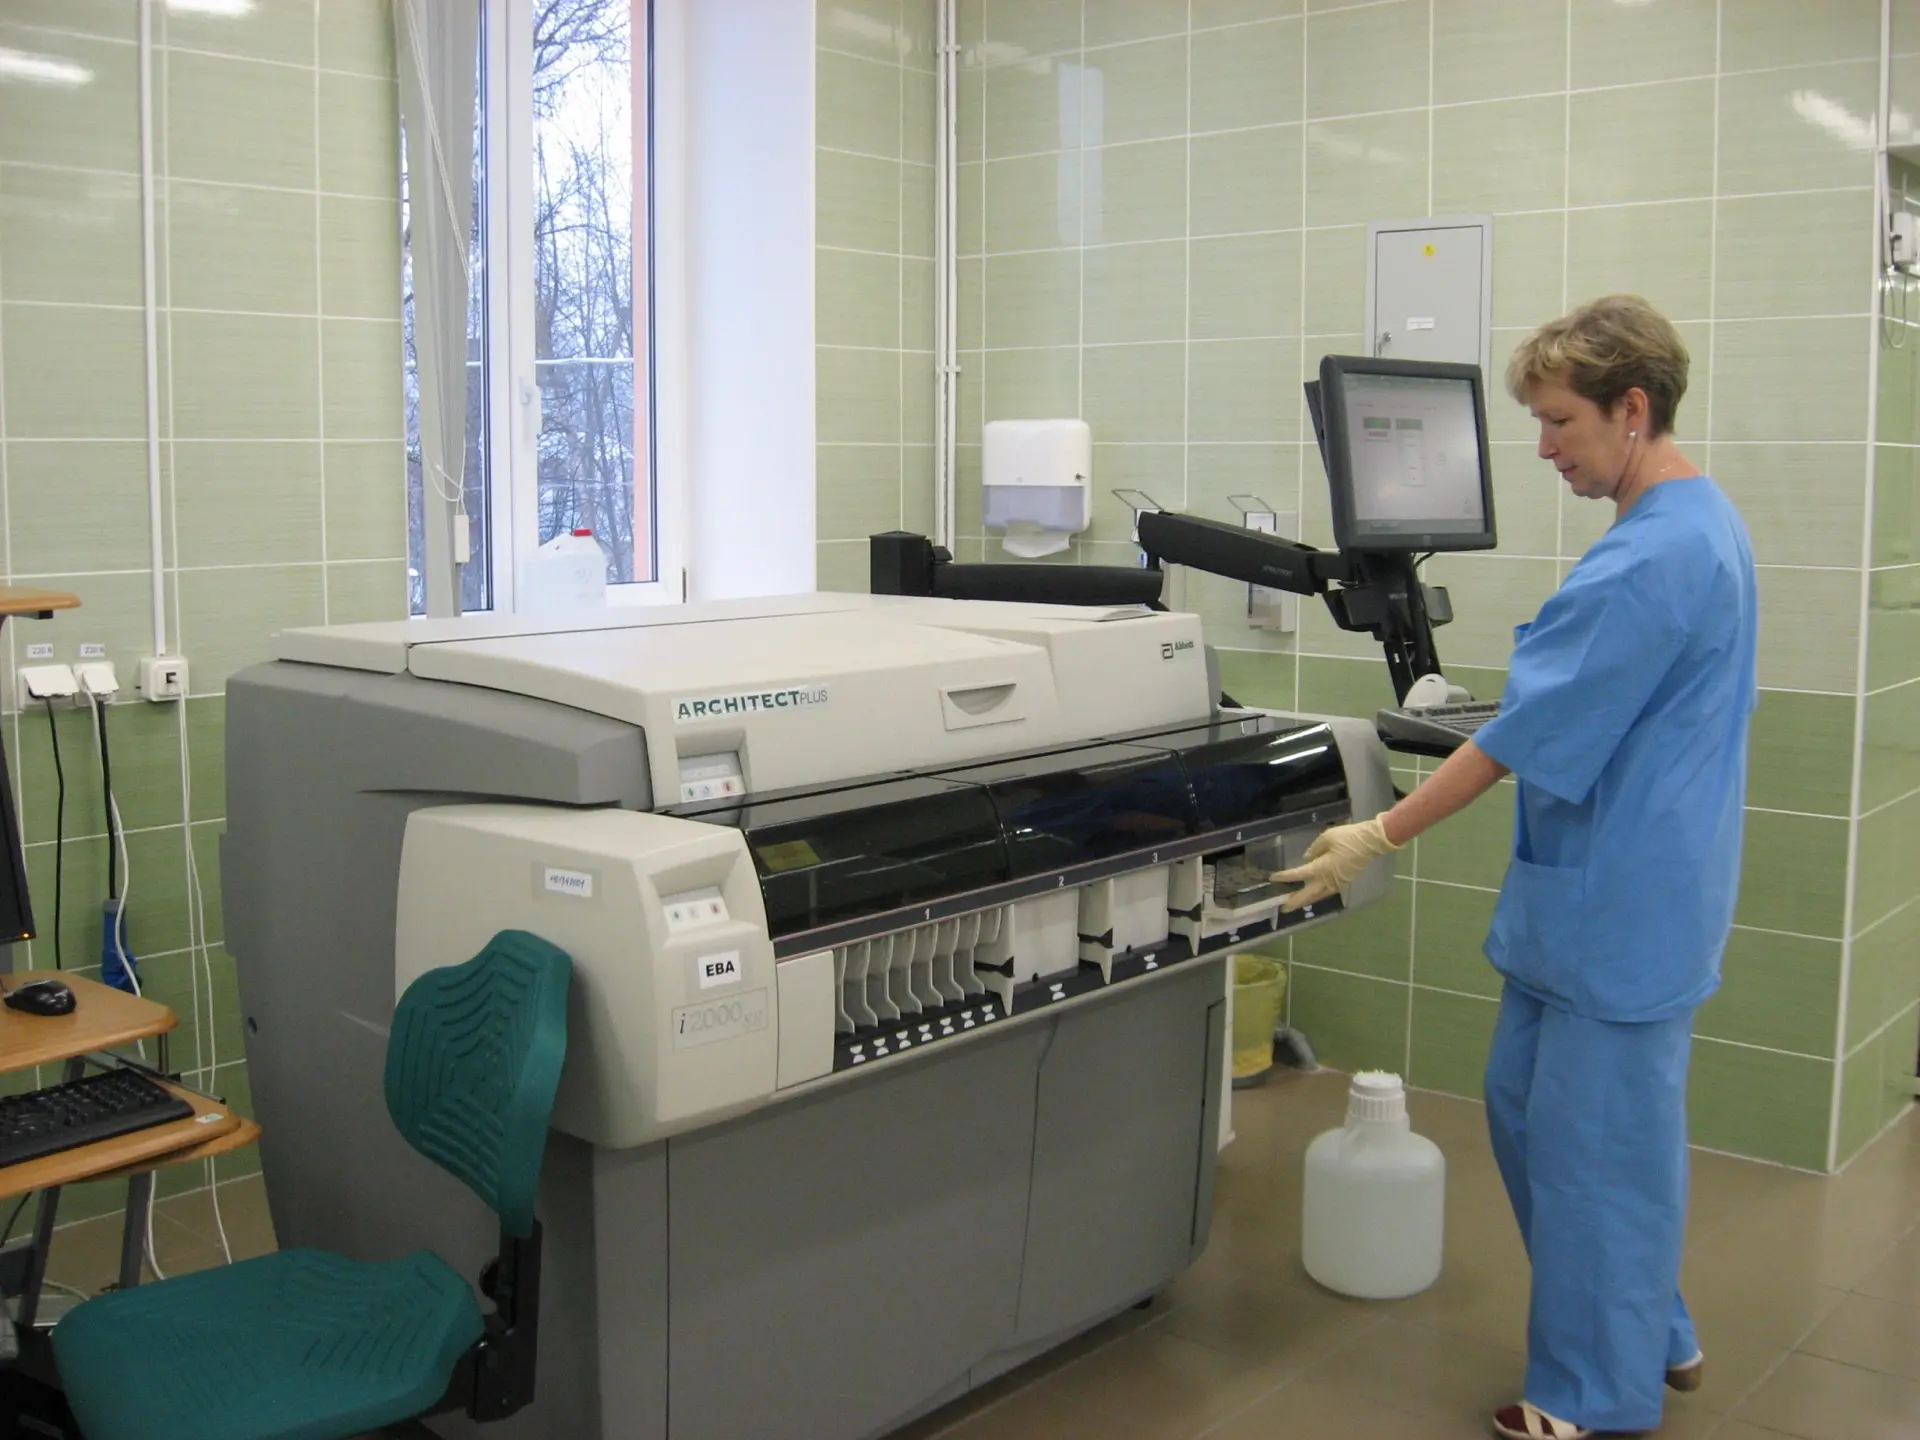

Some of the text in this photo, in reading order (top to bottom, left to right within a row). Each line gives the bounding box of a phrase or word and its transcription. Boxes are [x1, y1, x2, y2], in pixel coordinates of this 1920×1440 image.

[1236, 831, 1242, 842] 4
[1152, 852, 1159, 864] 3
[1058, 875, 1065, 887] 2
[924, 908, 930, 920] 1
[705, 960, 735, 977] EBA
